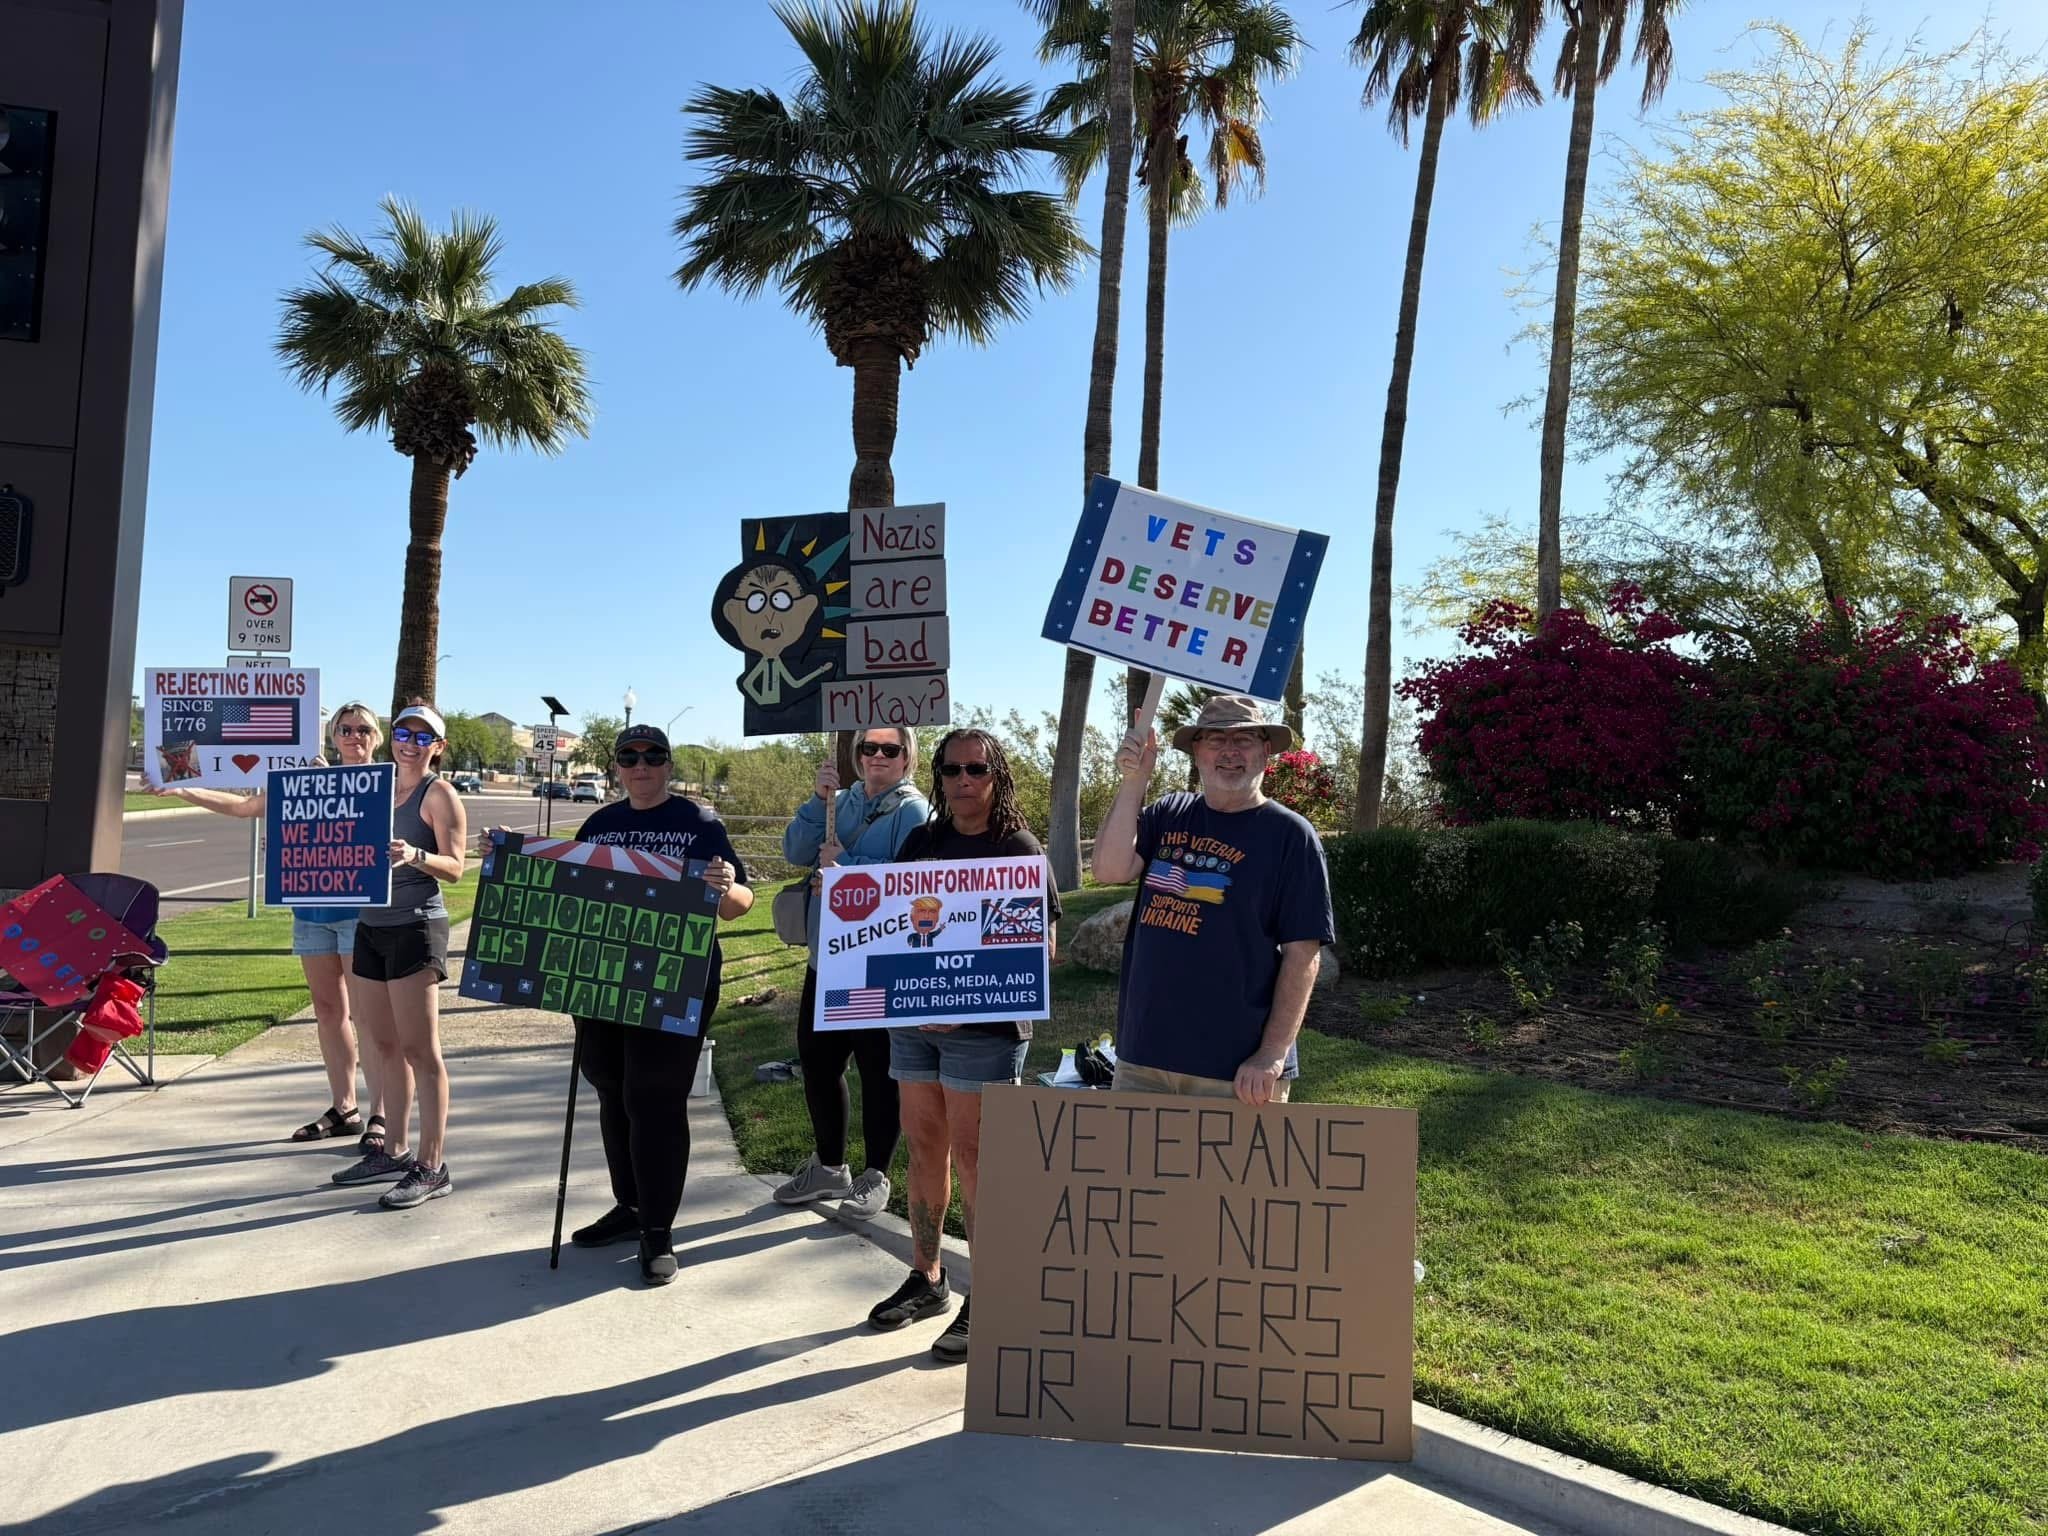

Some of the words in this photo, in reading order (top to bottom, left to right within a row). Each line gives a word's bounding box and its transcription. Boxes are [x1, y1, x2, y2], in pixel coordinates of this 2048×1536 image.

[863, 513, 936, 553] Nazis
[1147, 515, 1257, 565] VETS
[865, 576, 932, 609] are
[1100, 557, 1273, 629] DESERVE
[246, 619, 274, 629] OVER
[1088, 598, 1248, 667] BETTER
[238, 633, 246, 643] 9
[253, 634, 281, 644] TONS
[864, 621, 928, 663] bad
[156, 672, 248, 696] REJECTING
[254, 672, 306, 695] KINGS
[162, 700, 213, 713] SINCE
[829, 679, 946, 726] m'kay?
[163, 717, 207, 732] 1776
[535, 740, 555, 751] 45
[214, 757, 222, 772] I
[266, 756, 308, 769] USA
[282, 774, 337, 797] WE'RE
[342, 771, 382, 793] NOT
[281, 797, 364, 821] RADICAL.
[281, 823, 308, 844] WE
[313, 821, 356, 843] JUST
[588, 831, 627, 844] WHEN
[629, 831, 697, 846] TYRANNY
[281, 845, 376, 869] REMEMBER
[1161, 831, 1188, 846] THIS
[1190, 835, 1246, 864] VETERAN
[281, 870, 363, 893] HISTORY.
[506, 855, 556, 887] MY
[884, 865, 1041, 897] DISINFORMATION
[832, 887, 878, 908] STOP
[1150, 894, 1201, 916] SUPPORTS
[481, 884, 713, 957] DEMOCRACY
[1001, 906, 1040, 920] FOX
[1140, 906, 1203, 936] UKRAINE
[828, 912, 910, 956] SILENCE
[948, 911, 977, 923] AND
[990, 920, 1043, 934] NEWS
[477, 925, 528, 965] IS
[541, 933, 627, 981] NOT
[655, 953, 684, 992] A
[935, 954, 975, 970] NOT
[893, 976, 951, 991] JUDGES,
[954, 973, 1002, 989] MEDIA,
[1005, 972, 1035, 986] AND
[542, 976, 646, 1025] SALE
[892, 995, 928, 1009] CIVIL
[931, 992, 982, 1007] RIGHTS
[984, 990, 1037, 1005] VALUES
[1032, 1100, 1367, 1192] VETERANS
[1042, 1185, 1167, 1259] ARE
[1217, 1195, 1348, 1274] NOT
[1040, 1266, 1343, 1359] SUCKERS
[995, 1346, 1075, 1423] OR
[1125, 1354, 1386, 1446] LOSERS
